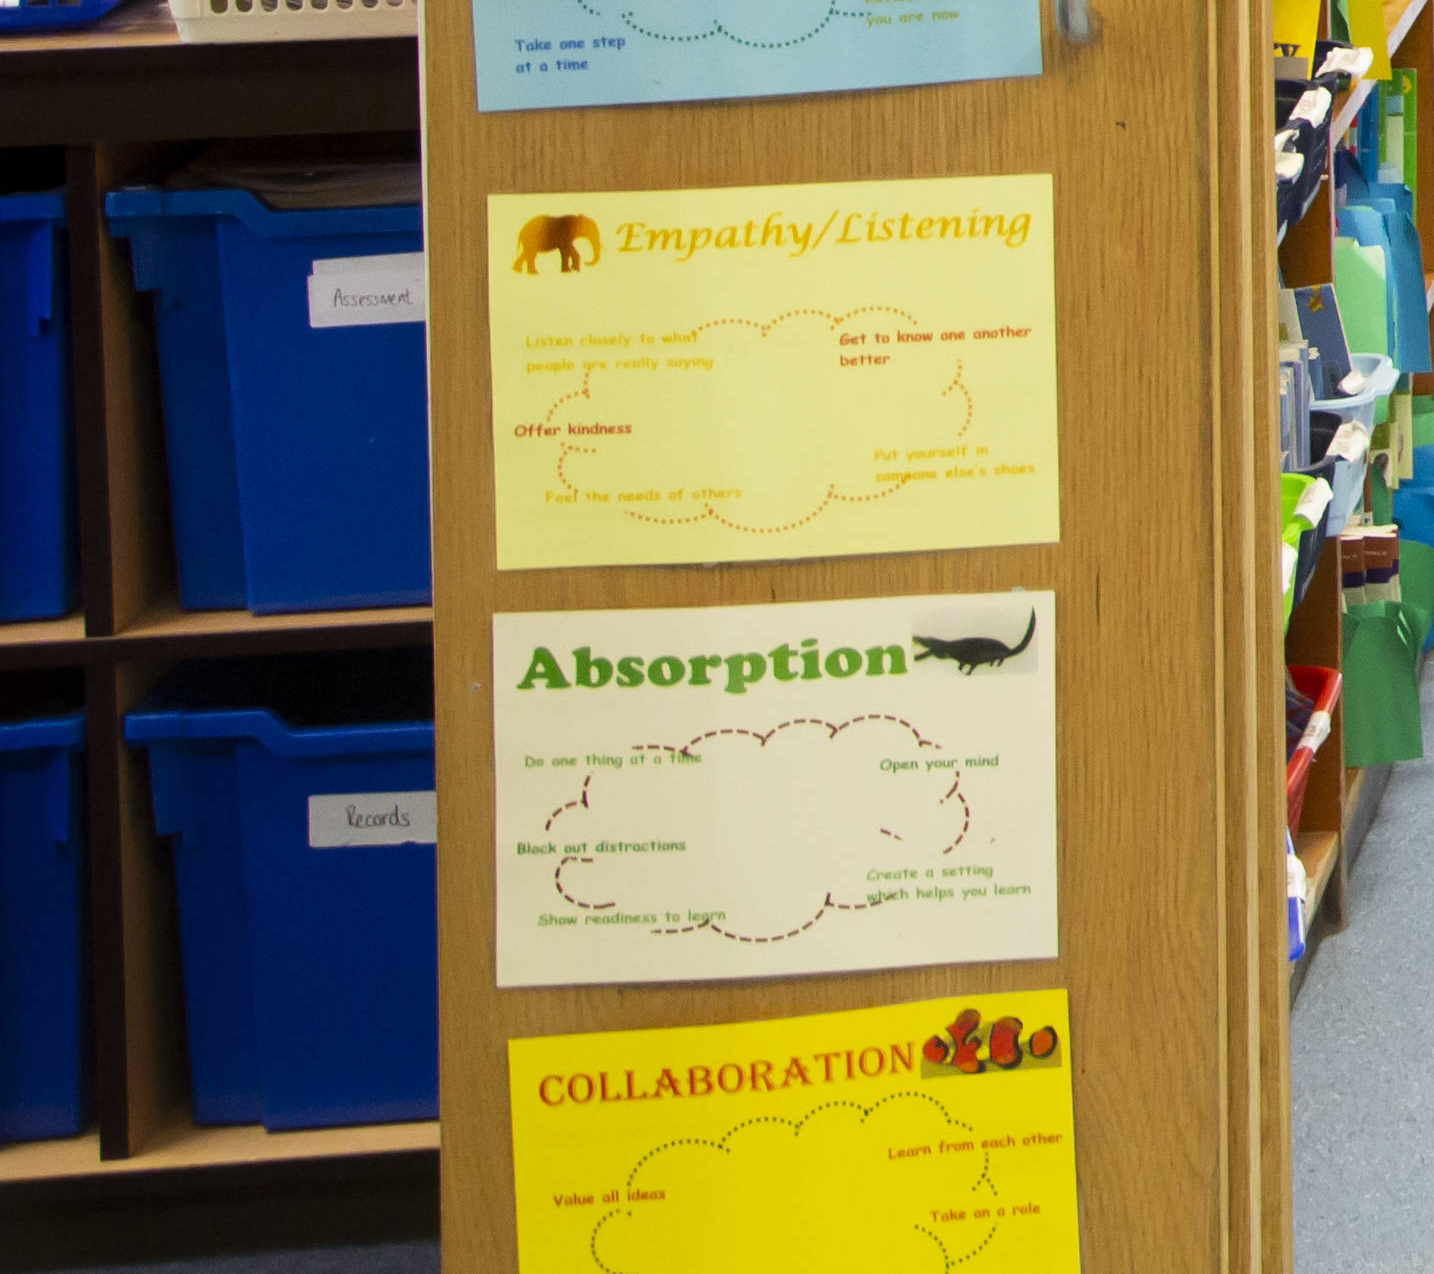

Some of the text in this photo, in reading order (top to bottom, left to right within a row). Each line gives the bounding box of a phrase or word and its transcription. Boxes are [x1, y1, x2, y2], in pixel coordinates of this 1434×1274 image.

[515, 35, 626, 52] Take one step
[516, 57, 588, 73] at a time
[616, 209, 1032, 262] Empathy/Listening
[333, 288, 415, 308] Assessment
[840, 326, 1032, 347] Get to know one another
[840, 353, 890, 367] better
[514, 422, 632, 437] Offer kindness
[516, 639, 908, 695] Absorption
[880, 755, 998, 773] Open your mind
[346, 805, 410, 828] Records
[518, 840, 686, 856] Block out distractions
[538, 1041, 915, 1108] COLLABORATION
[888, 1132, 1063, 1160] Learn from each other
[554, 1188, 666, 1208] Value all ideas
[930, 1203, 1040, 1223] Take on a role
